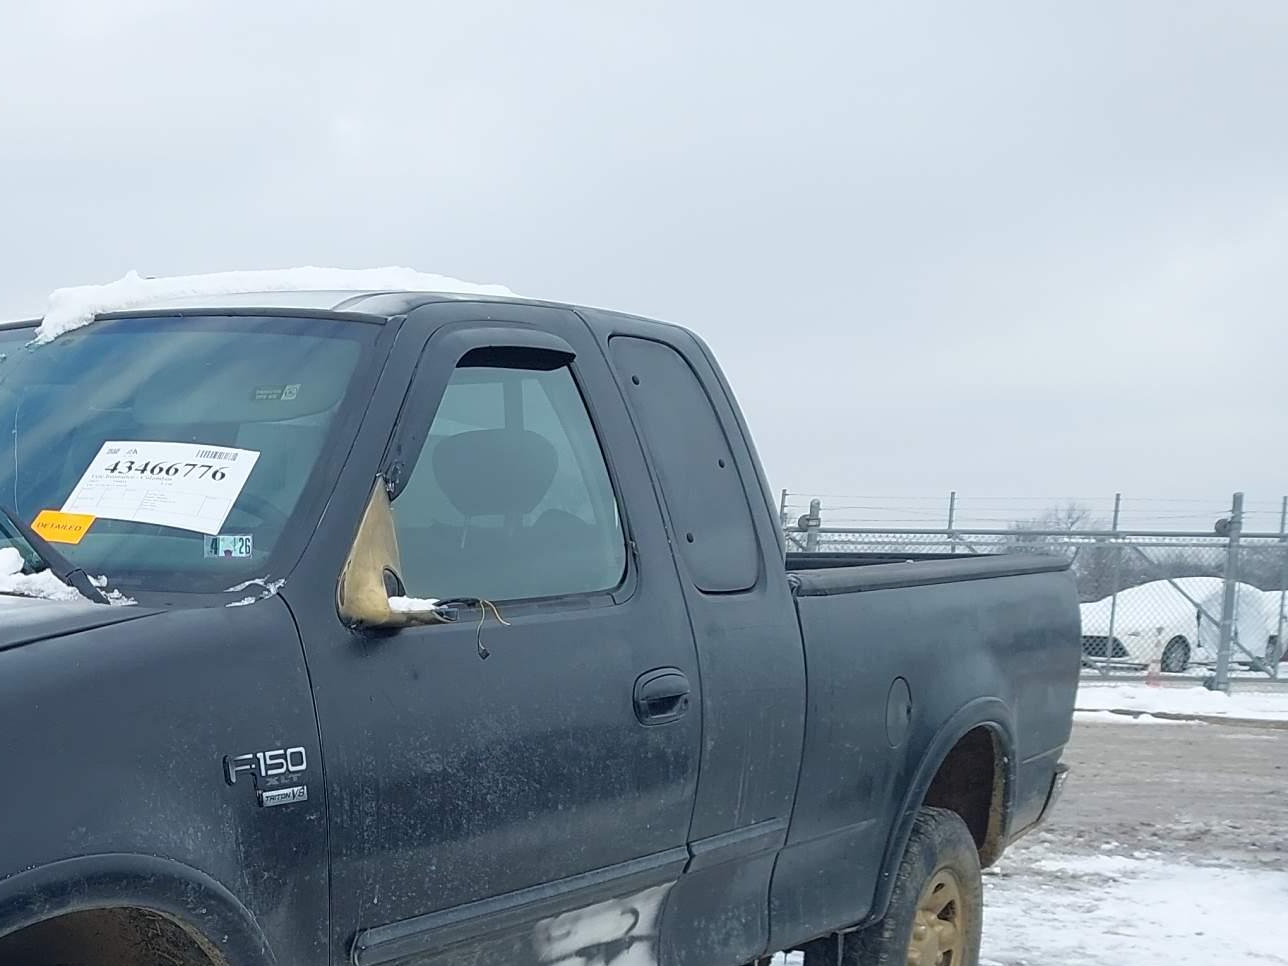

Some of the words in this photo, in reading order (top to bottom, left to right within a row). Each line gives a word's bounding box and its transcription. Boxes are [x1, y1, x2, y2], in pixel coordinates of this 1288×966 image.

[104, 460, 233, 481] 43466776
[36, 521, 83, 532] DETAILED
[238, 537, 251, 555] 26
[265, 773, 302, 786] XLT
[264, 792, 291, 803] TRITON
[291, 788, 306, 801] V8
